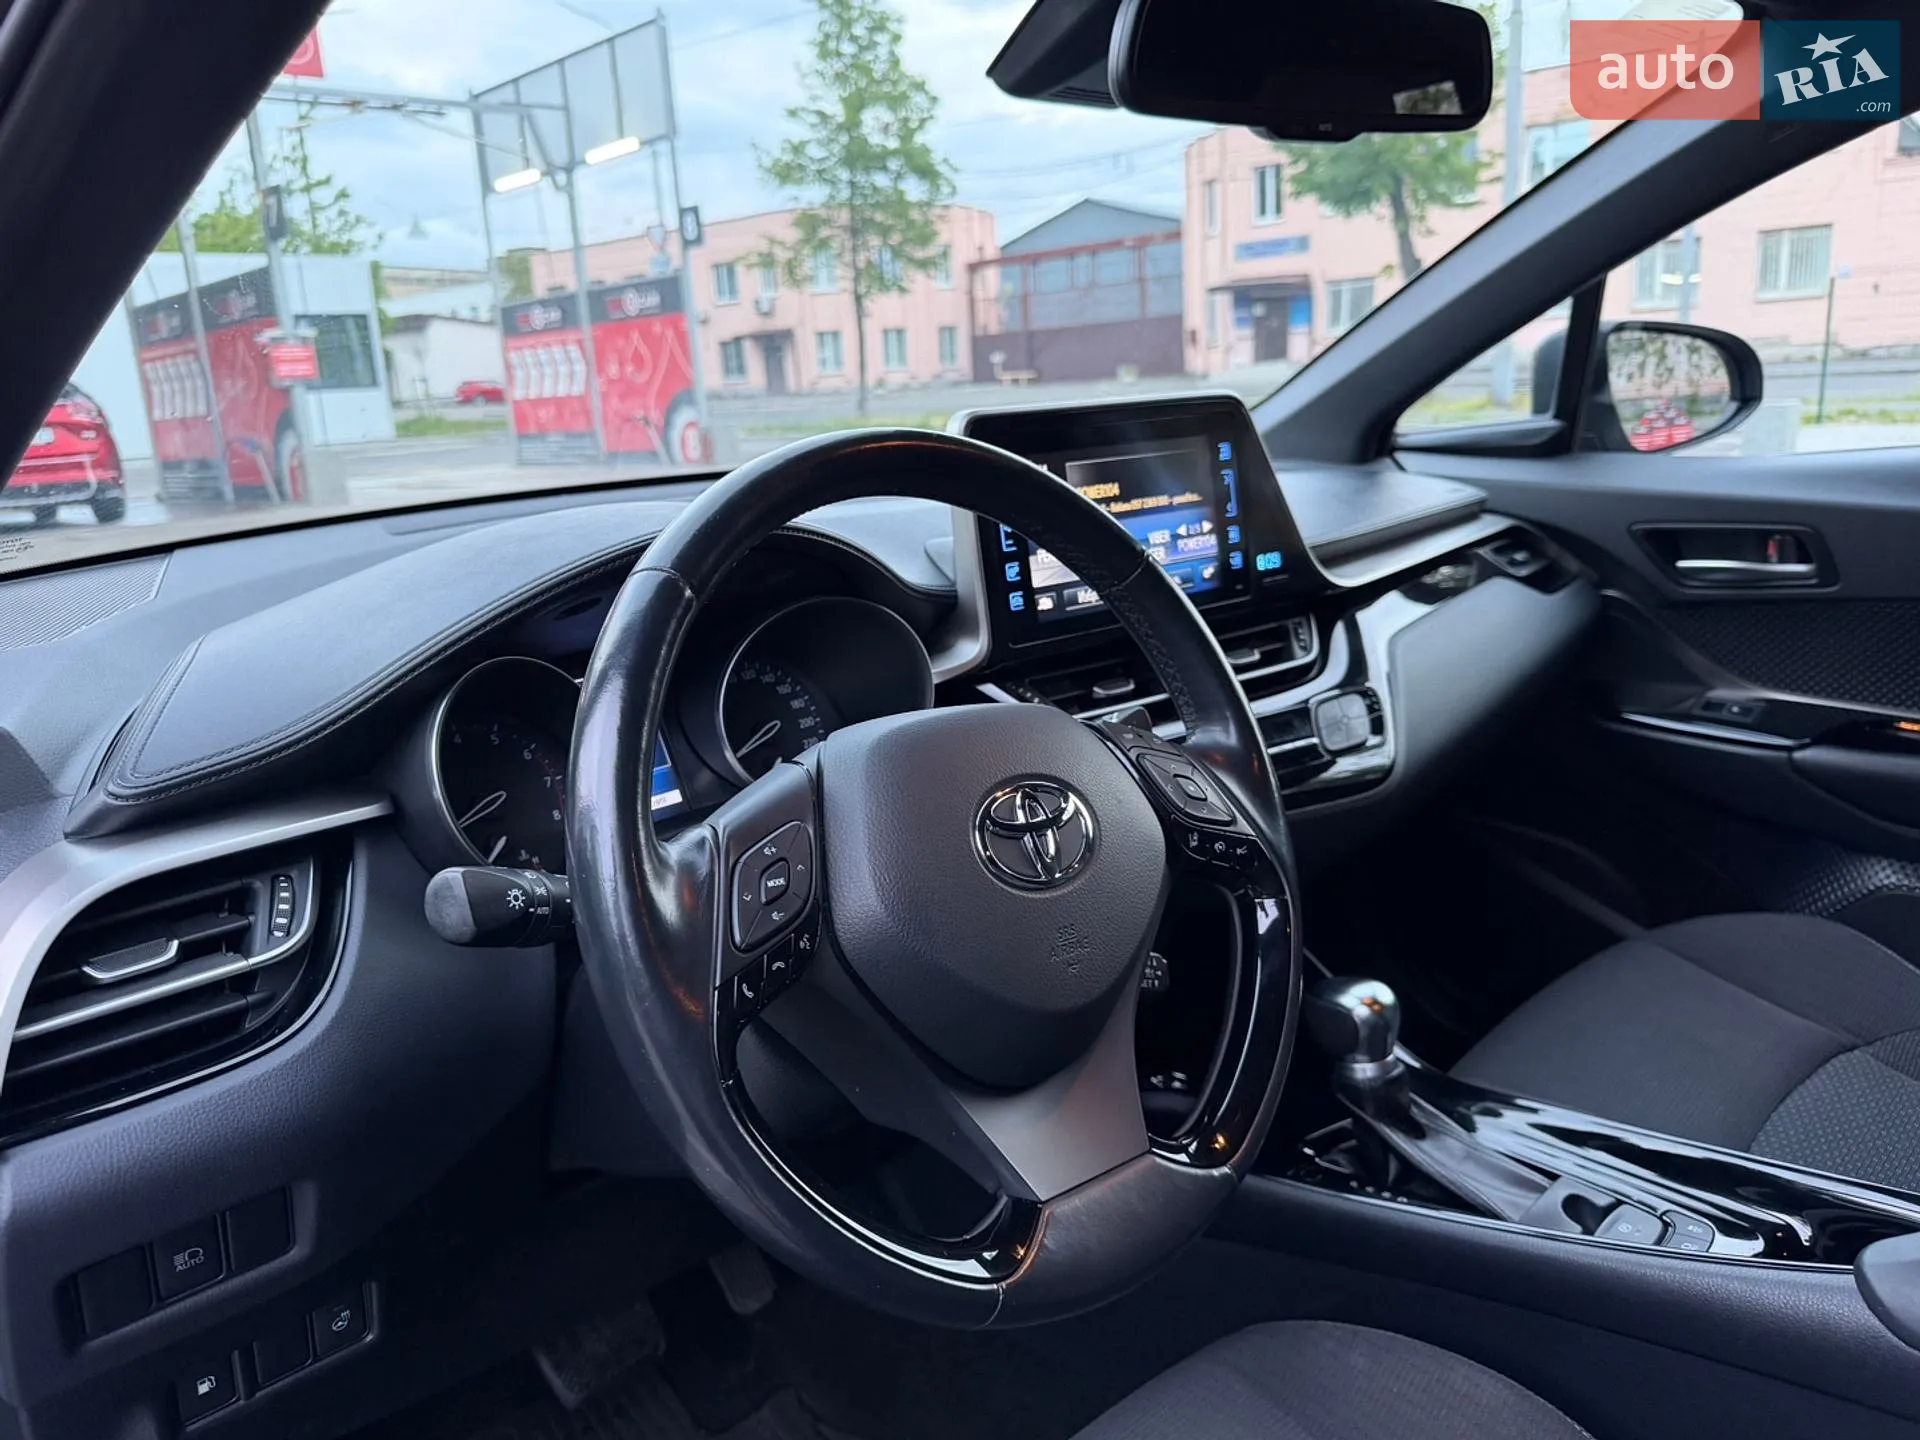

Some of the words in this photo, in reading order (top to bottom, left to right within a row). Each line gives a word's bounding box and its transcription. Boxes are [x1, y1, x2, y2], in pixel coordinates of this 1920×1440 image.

[775, 683, 792, 695] 160
[789, 698, 806, 709] 180
[798, 715, 815, 729] 200
[490, 733, 500, 745] 5
[523, 749, 533, 760] 6
[543, 775, 551, 788] 7
[552, 809, 561, 820] 8
[766, 876, 786, 888] MODE
[176, 1255, 204, 1272] AUTO
